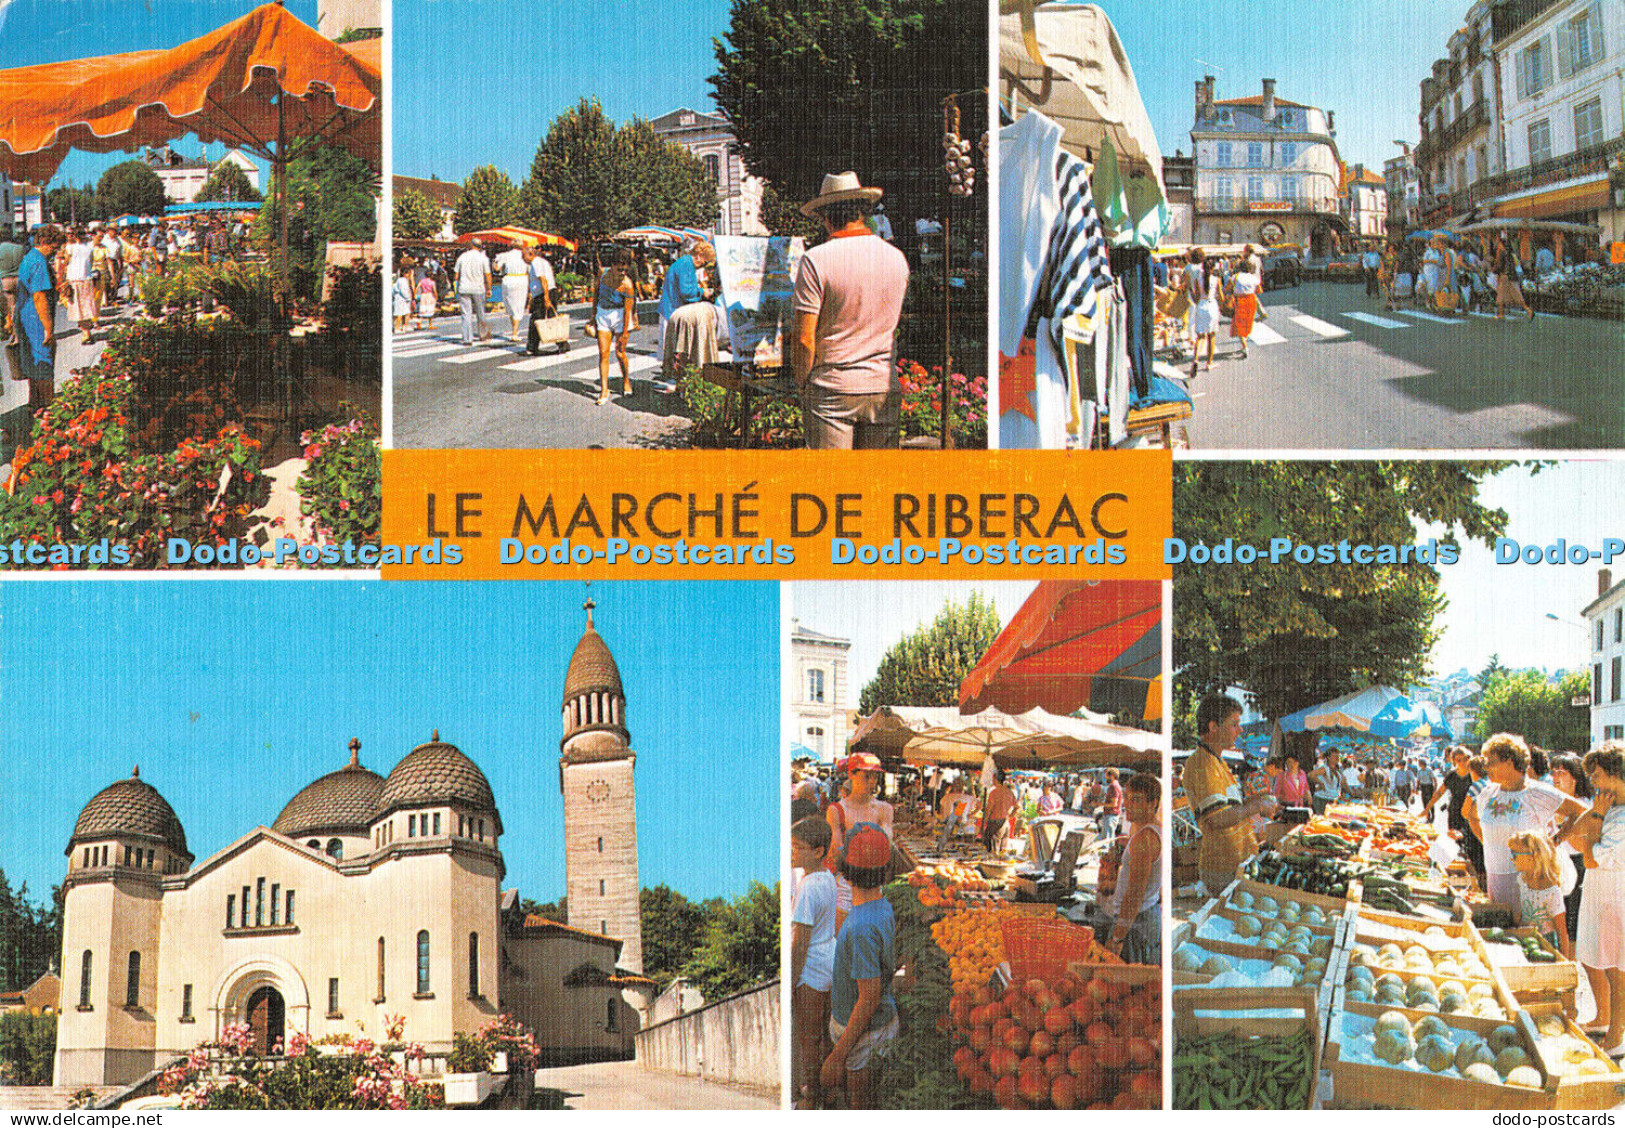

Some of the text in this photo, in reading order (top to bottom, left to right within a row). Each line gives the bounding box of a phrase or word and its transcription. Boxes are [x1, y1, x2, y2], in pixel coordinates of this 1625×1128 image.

[427, 481, 1128, 539] LE MARCHÉ DE RIBERAC
